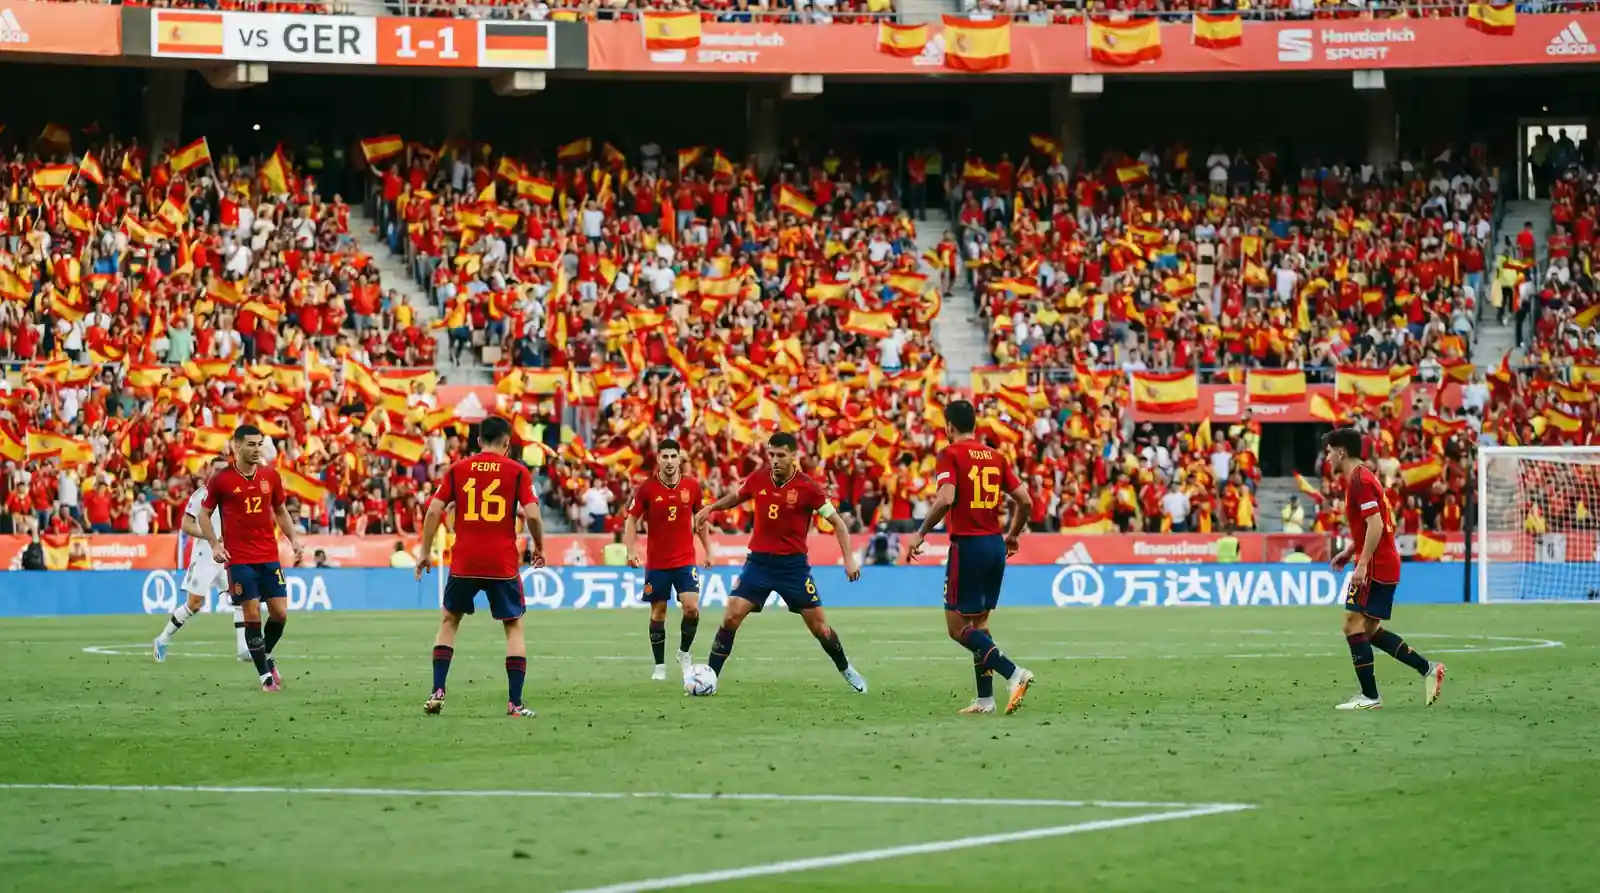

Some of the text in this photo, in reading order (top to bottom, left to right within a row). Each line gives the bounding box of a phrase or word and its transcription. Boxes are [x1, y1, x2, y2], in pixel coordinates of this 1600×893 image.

[283, 25, 361, 55] GER
[395, 26, 458, 59] 1-1
[1546, 43, 1596, 55] adidas
[1326, 46, 1389, 60] SPORT
[471, 461, 501, 472] PEDRI
[968, 464, 1000, 509] 15
[244, 496, 263, 514] 12
[463, 477, 506, 522] 16
[667, 505, 677, 522] 3
[767, 503, 780, 520] 8
[804, 577, 816, 595] 6
[1113, 568, 1211, 606] 万达
